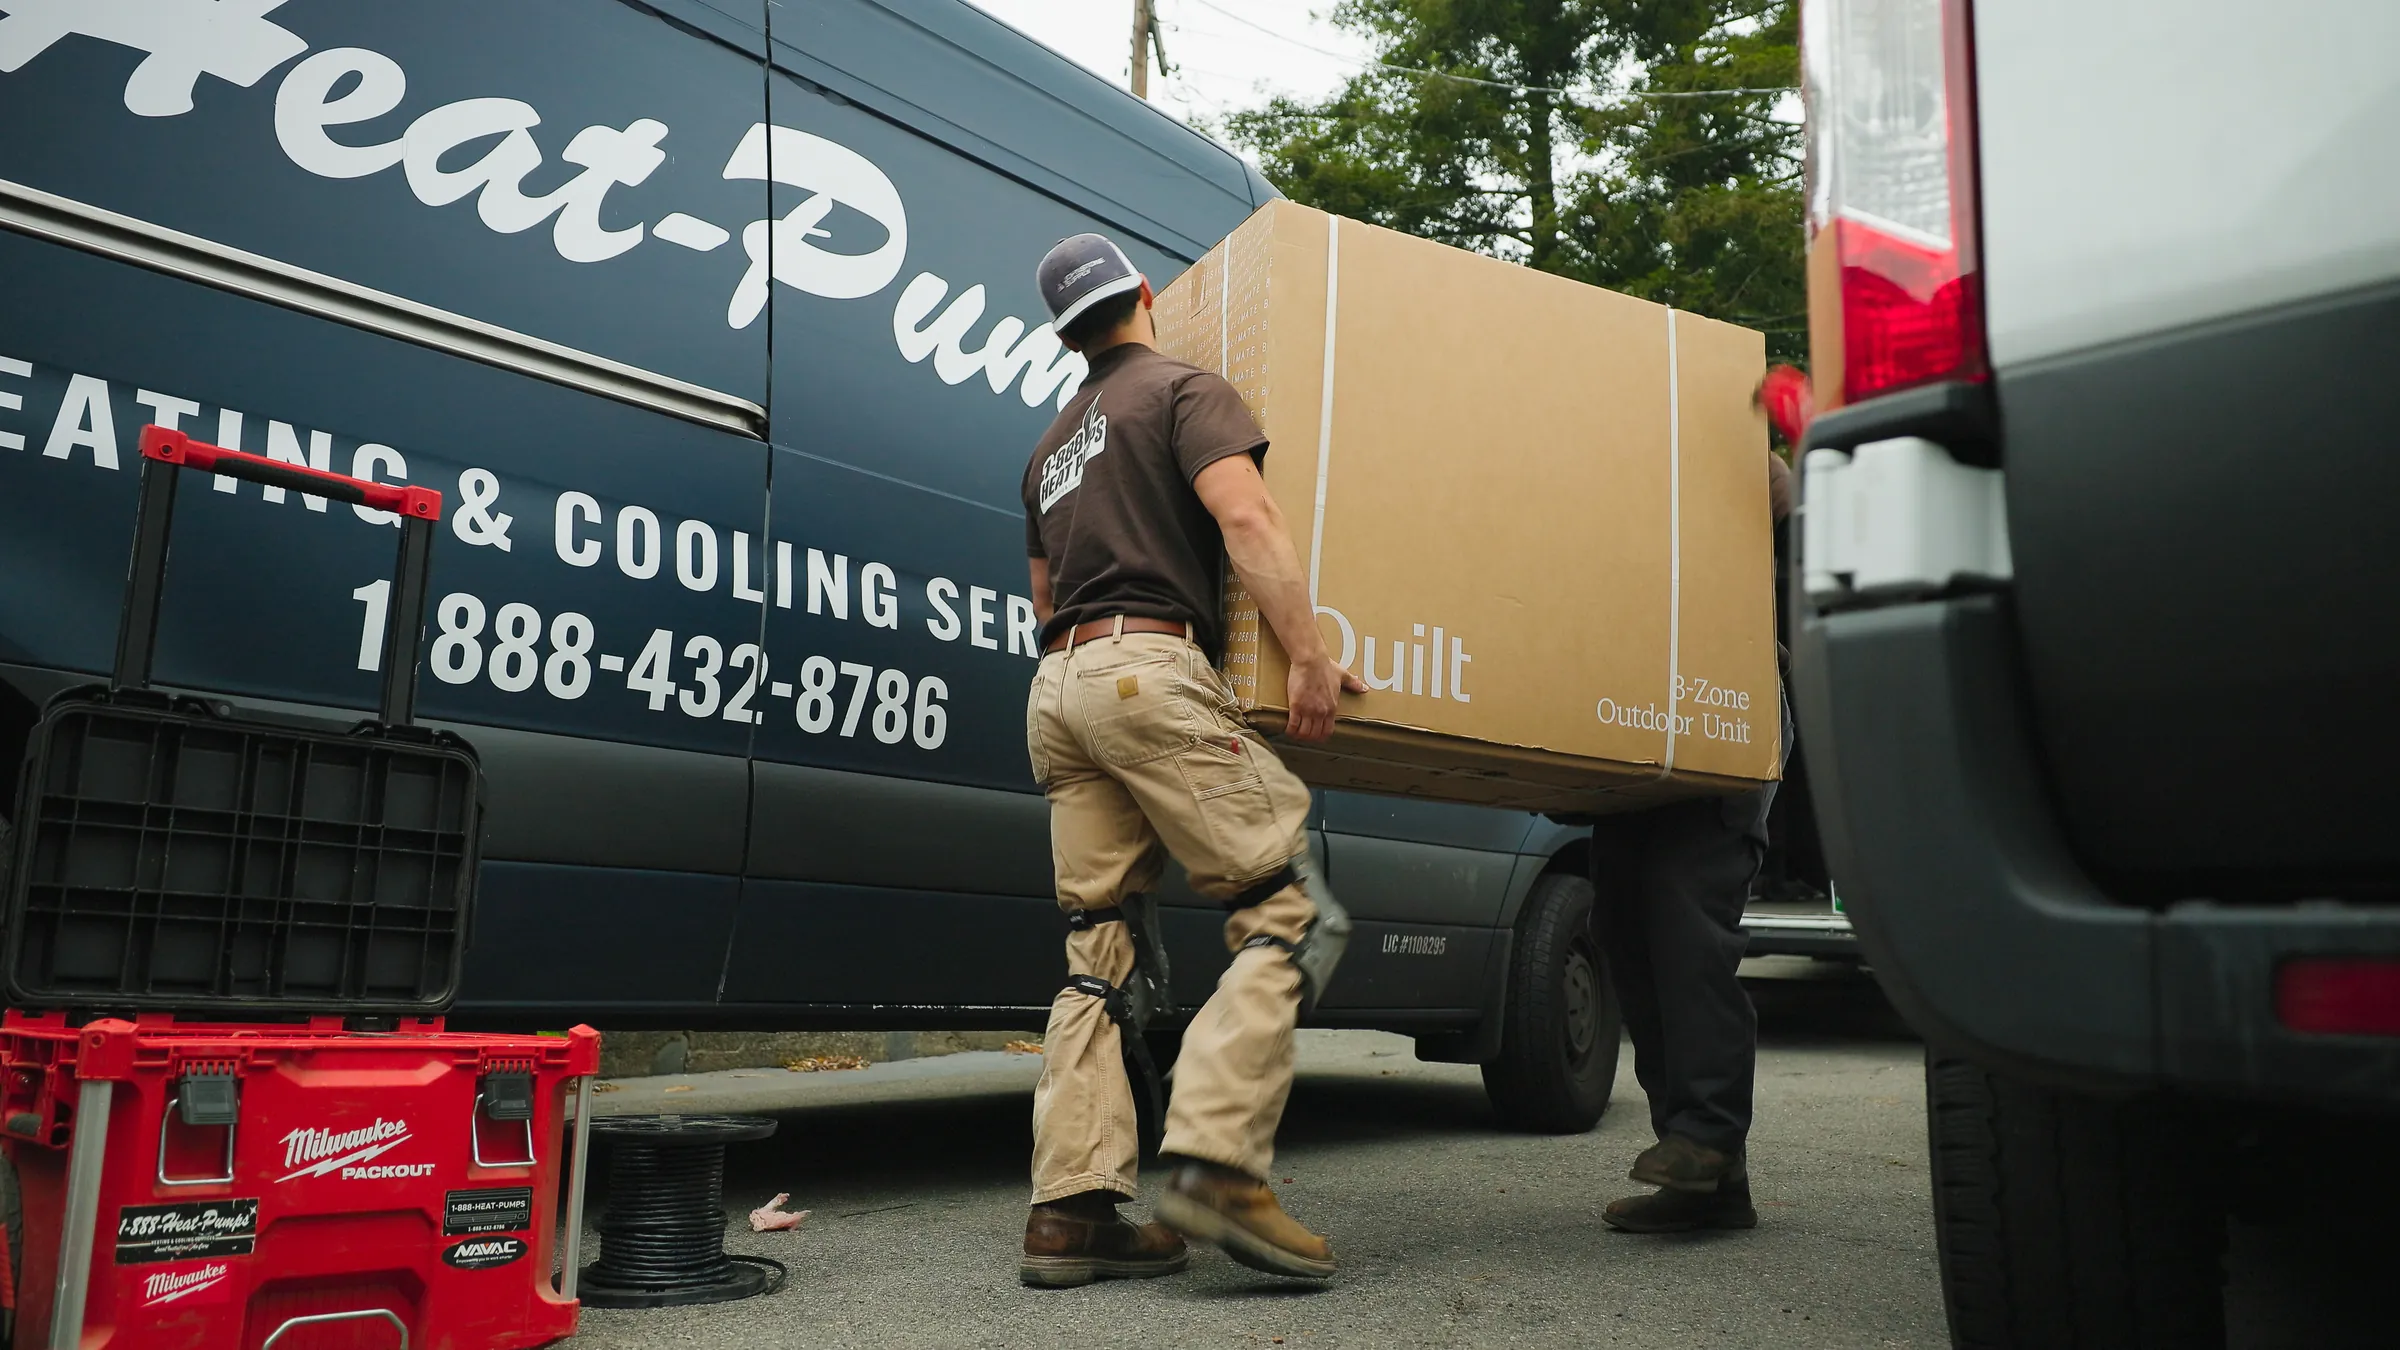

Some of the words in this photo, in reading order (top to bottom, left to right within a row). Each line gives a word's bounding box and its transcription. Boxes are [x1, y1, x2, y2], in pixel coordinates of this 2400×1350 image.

[1044, 431, 1084, 480] 1-888
[1041, 461, 1073, 504] HEAT
[451, 467, 512, 552] &
[555, 491, 898, 630] COOLING
[926, 577, 1039, 659] SER
[352, 579, 948, 750] 1888-432-8786
[1674, 674, 1750, 711] 3-Zone
[1596, 697, 1695, 736] Outdoor
[1702, 712, 1751, 744] Unit
[1382, 934, 1399, 953] LIC
[278, 1117, 407, 1168] Milwaukee
[342, 1163, 435, 1180] PACKOUT
[118, 1208, 251, 1236] 1-888-Heat-Pumps
[453, 1240, 518, 1258] NAVAC
[143, 1263, 227, 1299] Milwaukee
